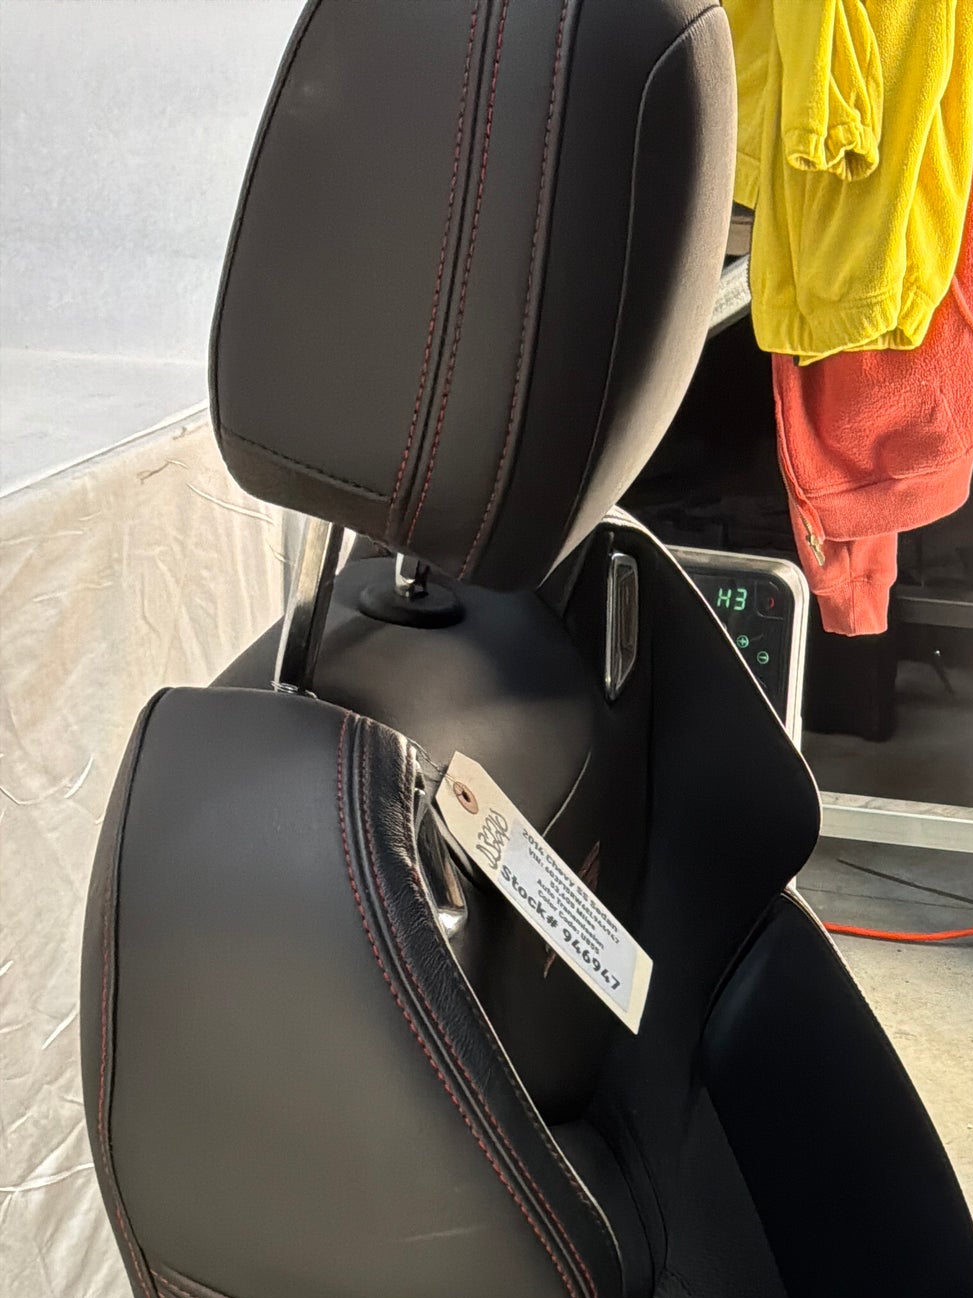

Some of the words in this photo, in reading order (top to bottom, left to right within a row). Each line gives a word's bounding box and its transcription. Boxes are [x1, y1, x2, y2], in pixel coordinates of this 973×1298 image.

[716, 587, 748, 611] H3
[522, 828, 545, 856] 2014
[545, 854, 576, 888] Chevy
[589, 899, 618, 933] Sedan
[528, 847, 544, 868] VIN:
[500, 864, 559, 928] Stock#
[562, 927, 621, 990] 946947
[536, 878, 555, 900] Auto
[556, 897, 605, 950] Transmission
[537, 889, 558, 912] Color
[558, 910, 580, 935] Code:
[575, 907, 596, 931] Miles
